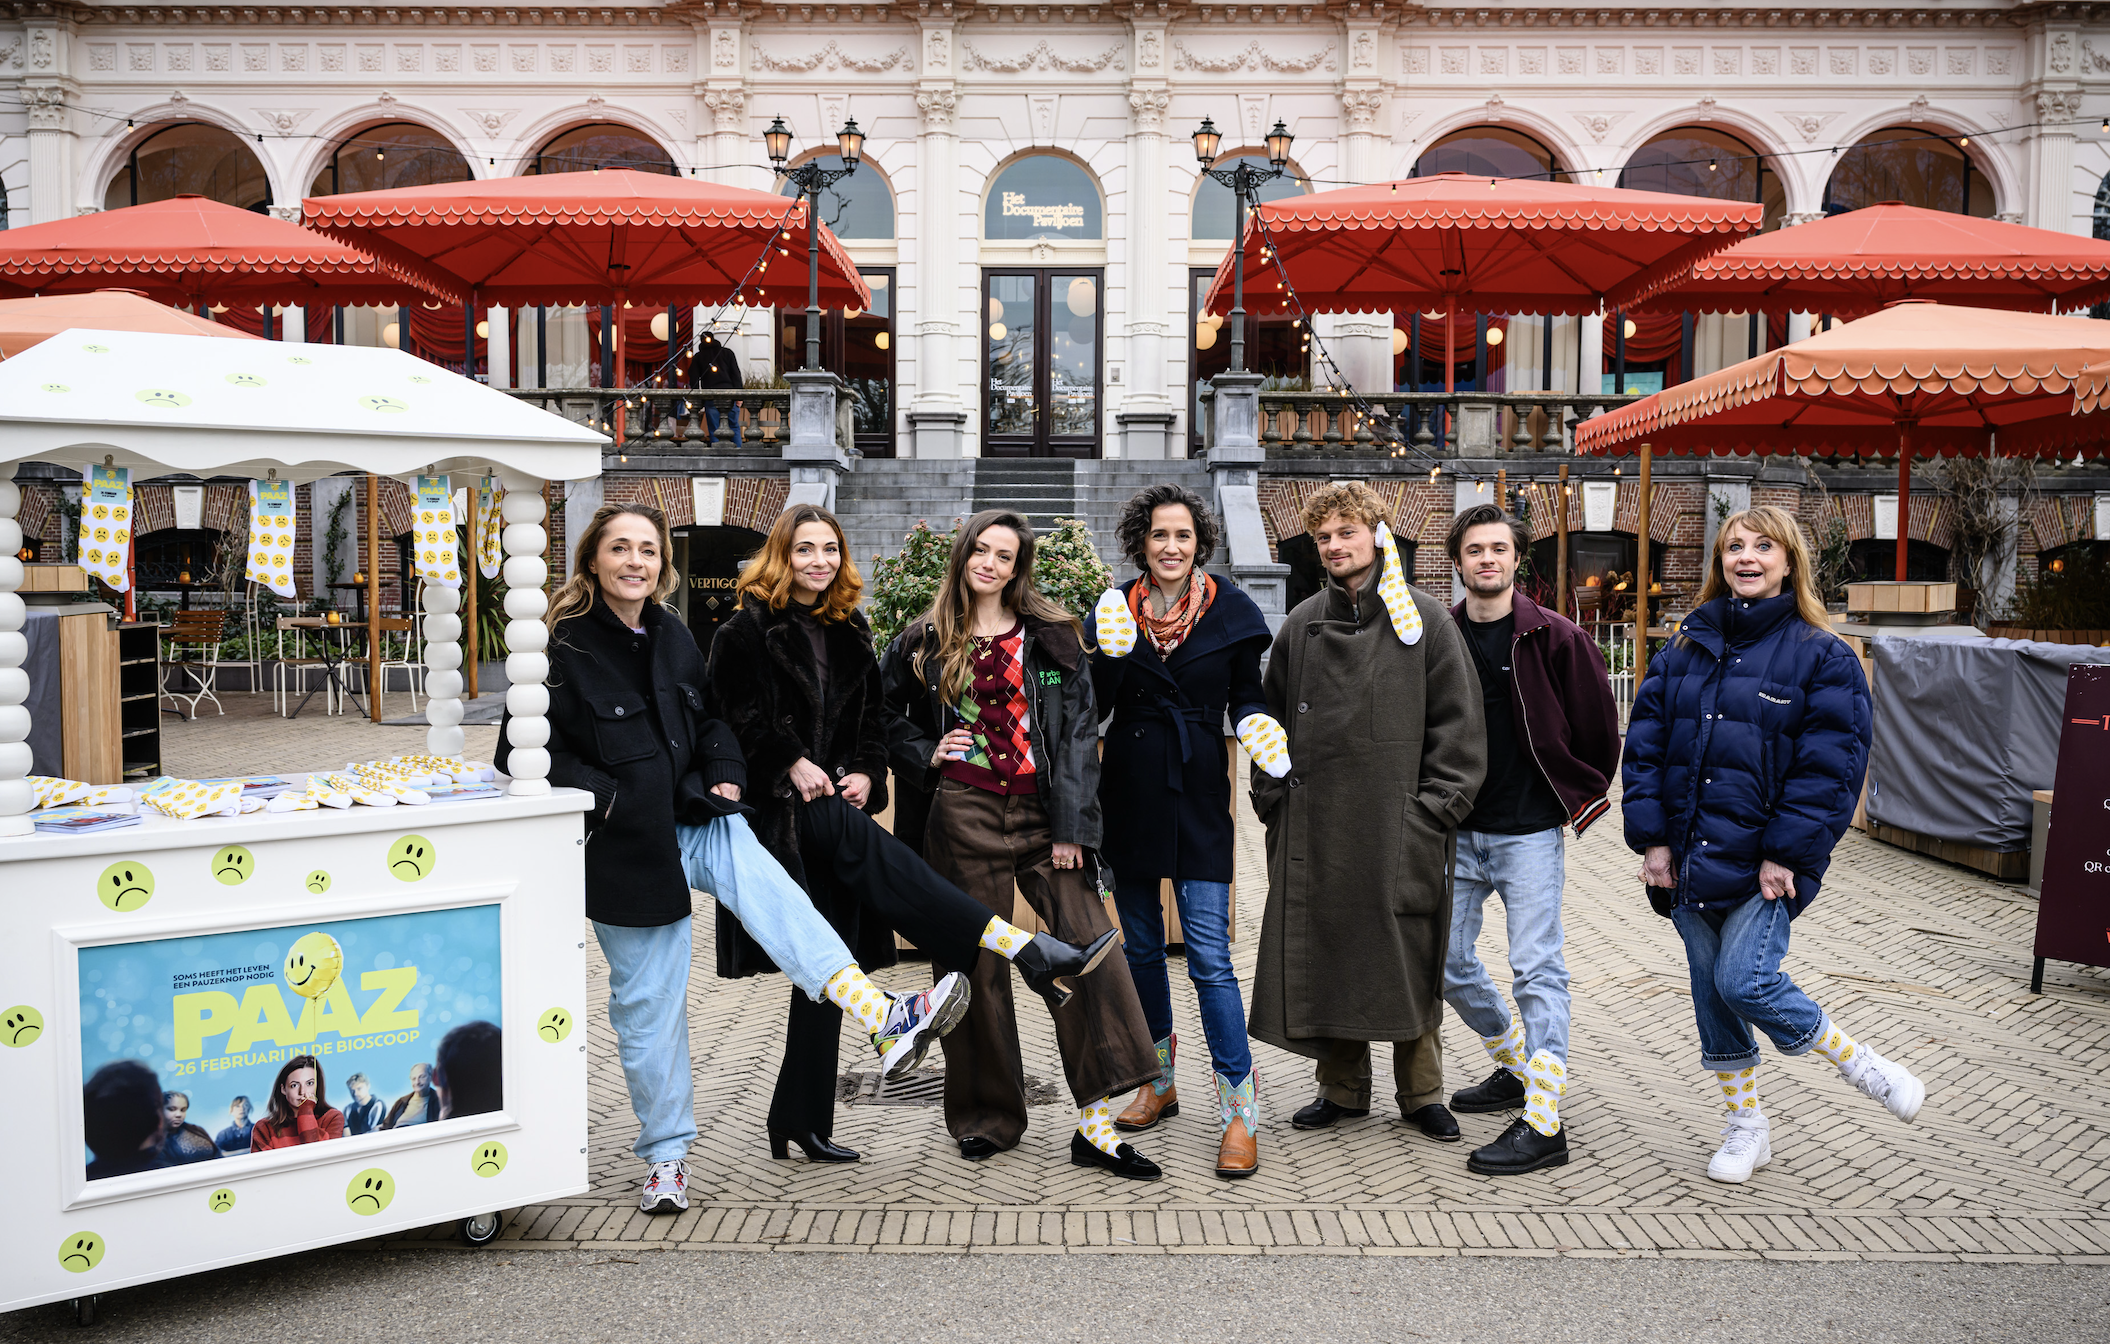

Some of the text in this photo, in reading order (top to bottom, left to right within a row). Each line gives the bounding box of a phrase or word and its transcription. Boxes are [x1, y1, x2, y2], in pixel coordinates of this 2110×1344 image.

[1002, 191, 1025, 205] Het
[1002, 202, 1084, 216] Documentaire
[1033, 214, 1084, 230] Paviljoen
[94, 479, 125, 490] PAAZ
[420, 487, 446, 495] PAAZ
[260, 491, 288, 500] PAAZ
[689, 578, 739, 589] VERTIGO
[2084, 860, 2103, 873] QR
[173, 964, 270, 982] SOMS HEEFT HET LEVEN
[173, 971, 275, 989] EEN PAUZEKNOP NODIG
[173, 966, 420, 1061] PAAZ
[174, 1030, 420, 1077] 26 FEBRUARI IN DE BIOSCOOP
